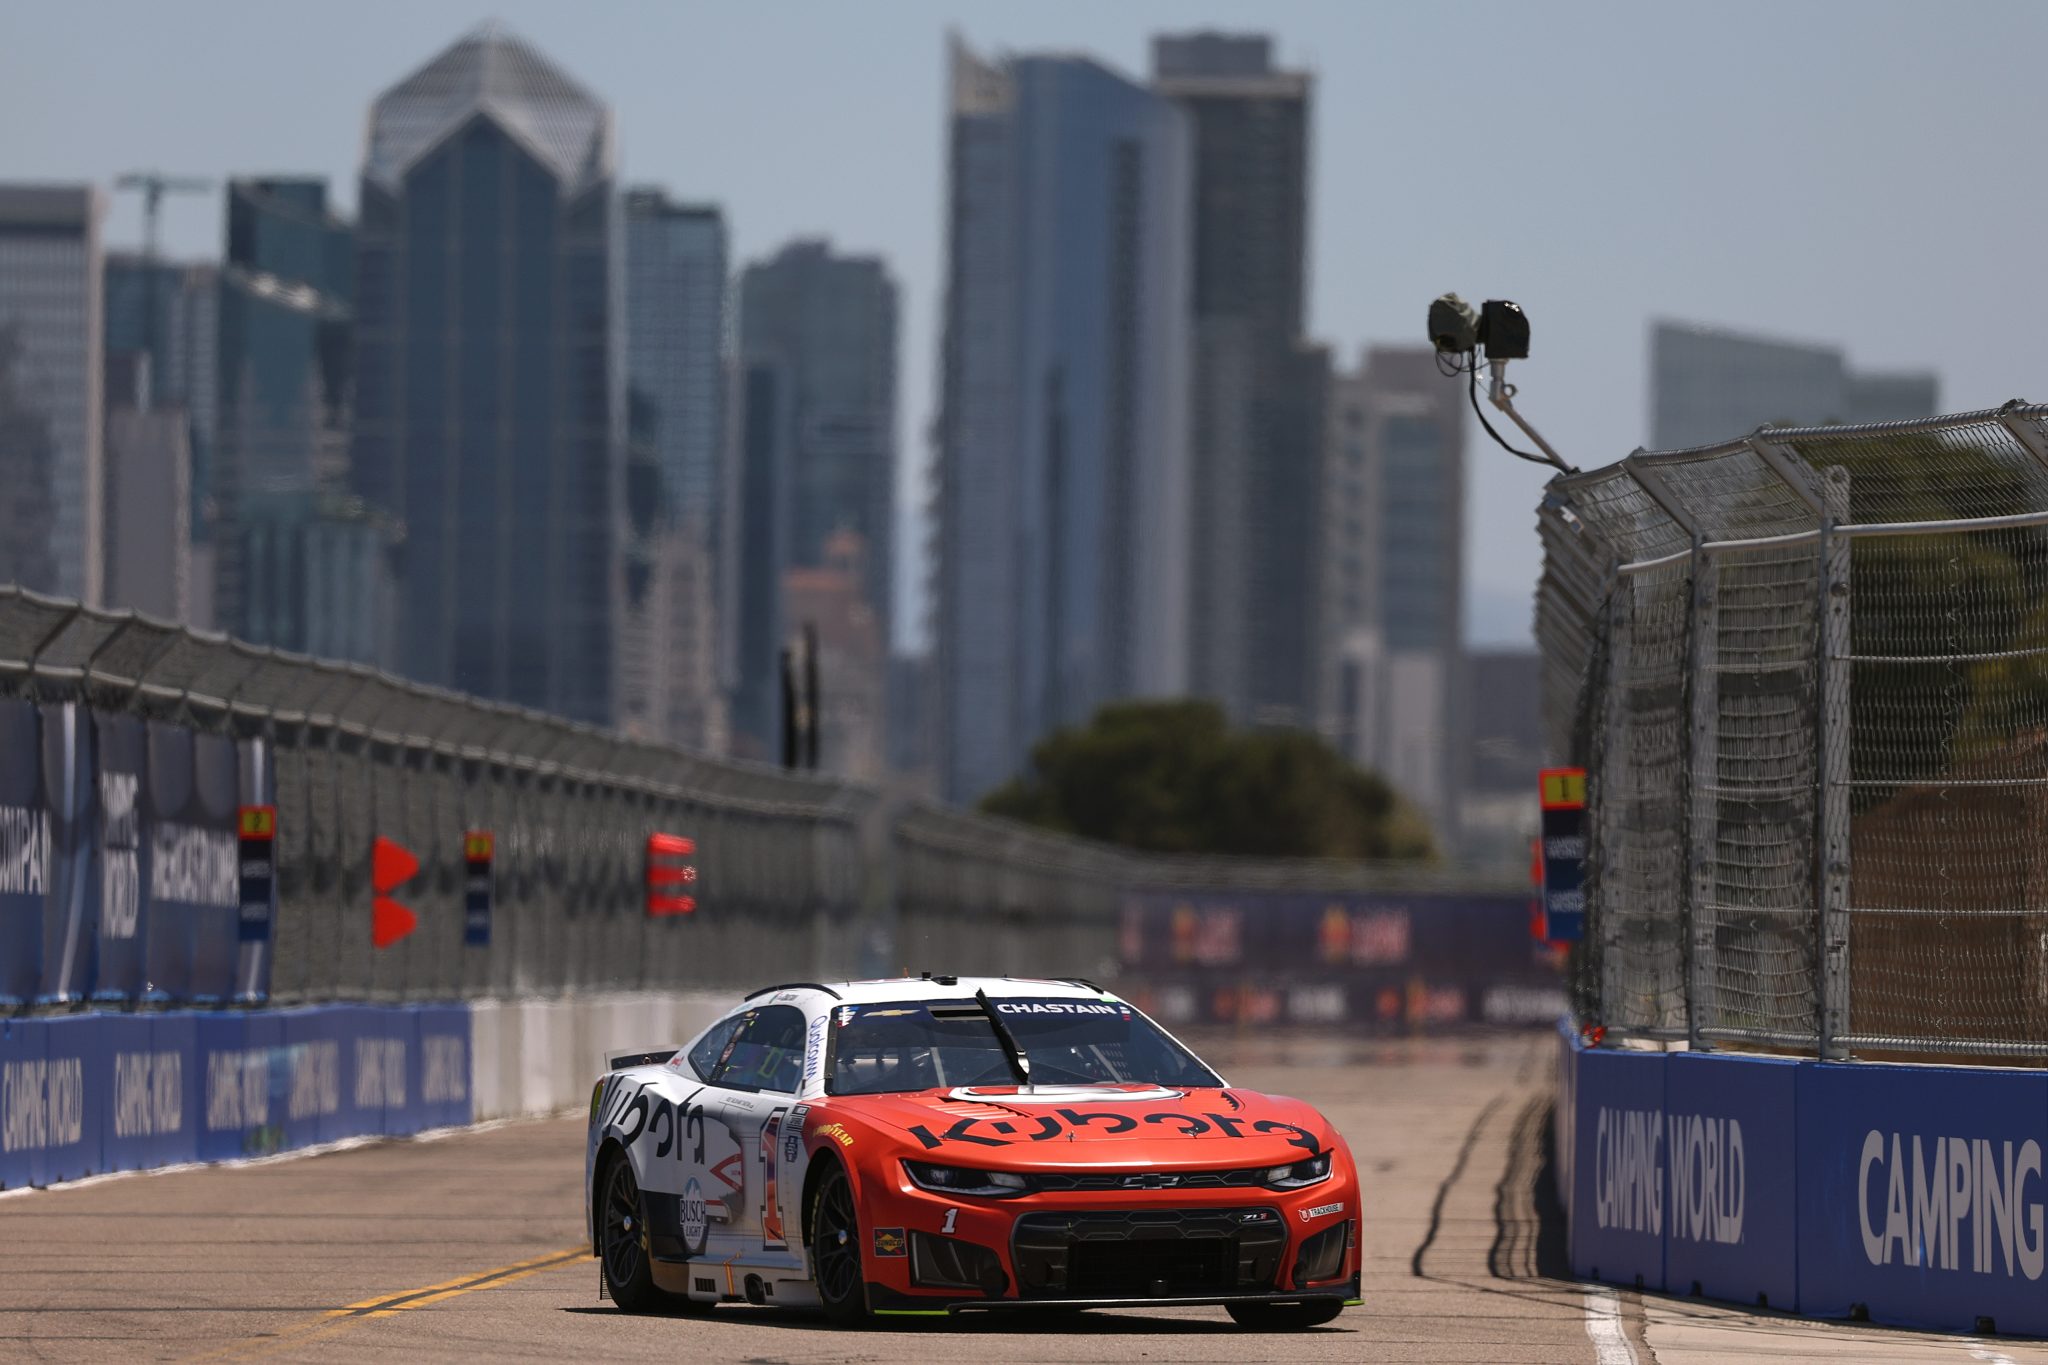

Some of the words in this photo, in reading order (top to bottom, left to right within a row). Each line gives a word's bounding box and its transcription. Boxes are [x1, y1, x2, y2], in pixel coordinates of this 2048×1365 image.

[997, 1003, 1118, 1014] CHASTAIN
[806, 1015, 828, 1080] Qualcomm
[1597, 1106, 1663, 1236] CAMPING
[1668, 1114, 1744, 1244] WORLD
[680, 1200, 706, 1225] BUSCH
[1310, 1203, 1339, 1217] TRACKHOUSE
[1858, 1129, 2045, 1281] CAMPING
[941, 1208, 959, 1233] 1
